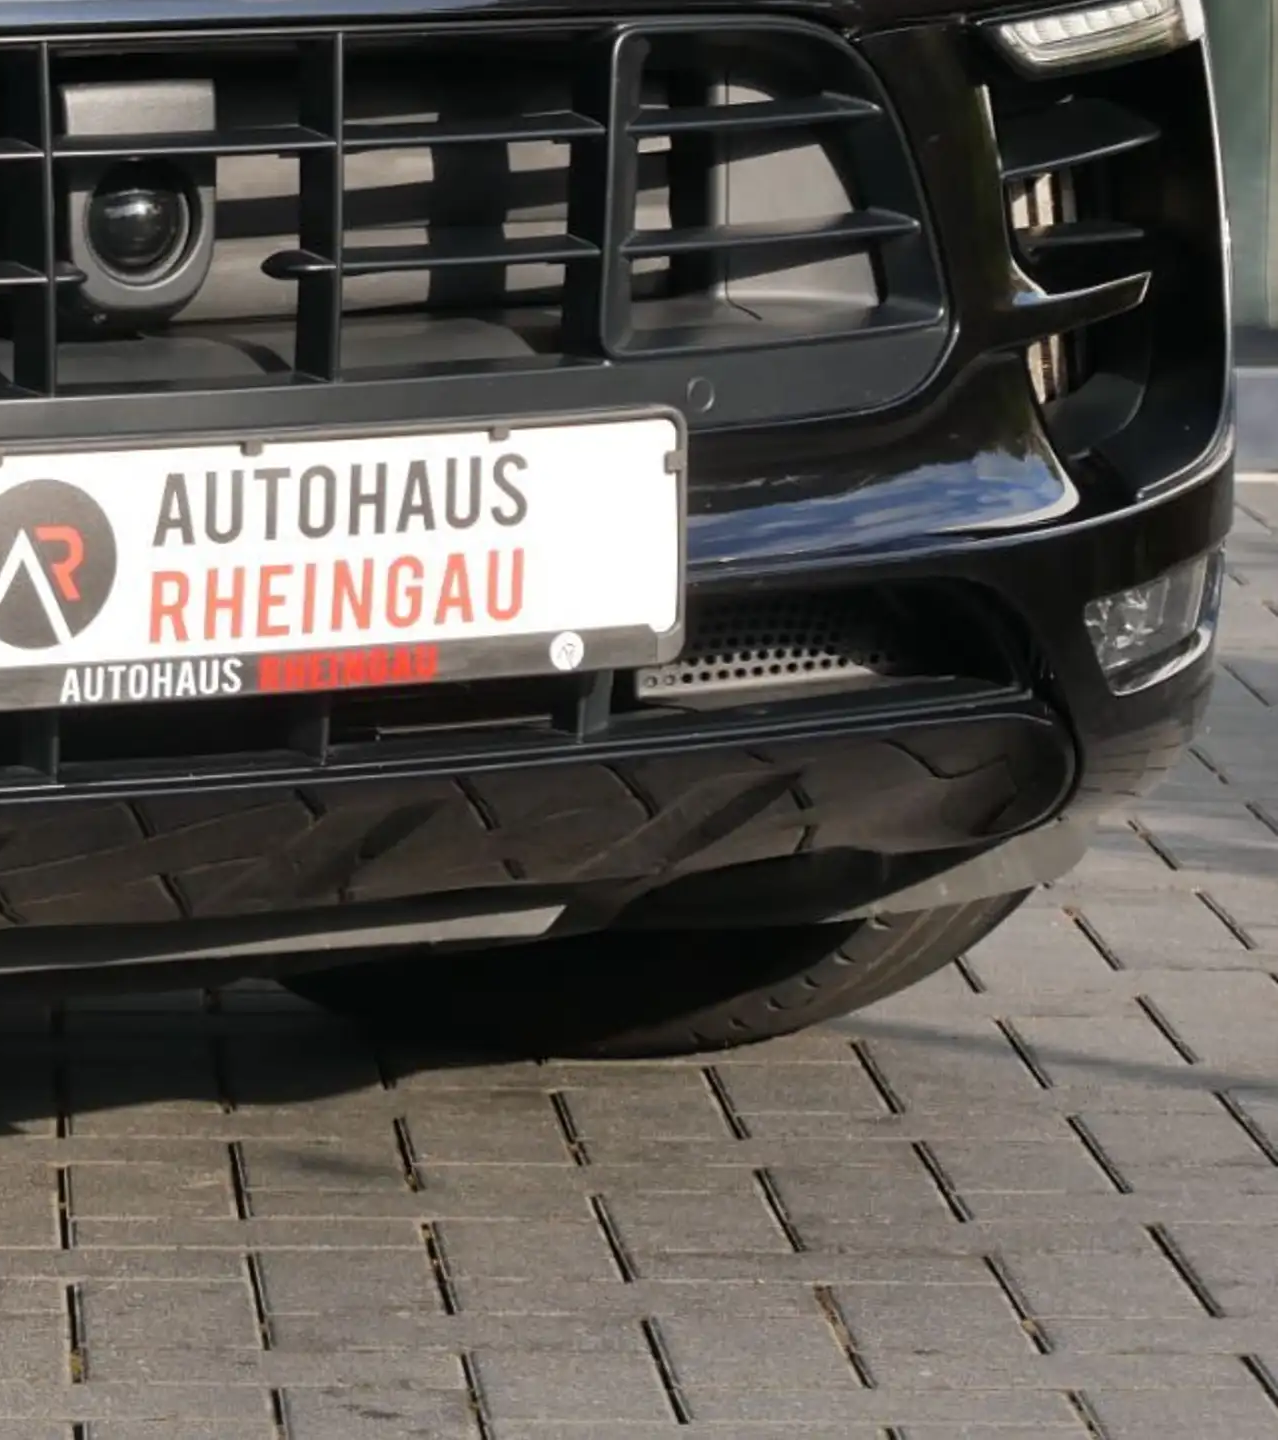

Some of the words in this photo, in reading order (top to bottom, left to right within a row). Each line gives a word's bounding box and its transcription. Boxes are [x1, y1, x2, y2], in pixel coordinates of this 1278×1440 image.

[152, 452, 529, 547] AUTOHAUS
[148, 548, 525, 644] RHEINGAU
[59, 657, 243, 703] AUTOHAUS
